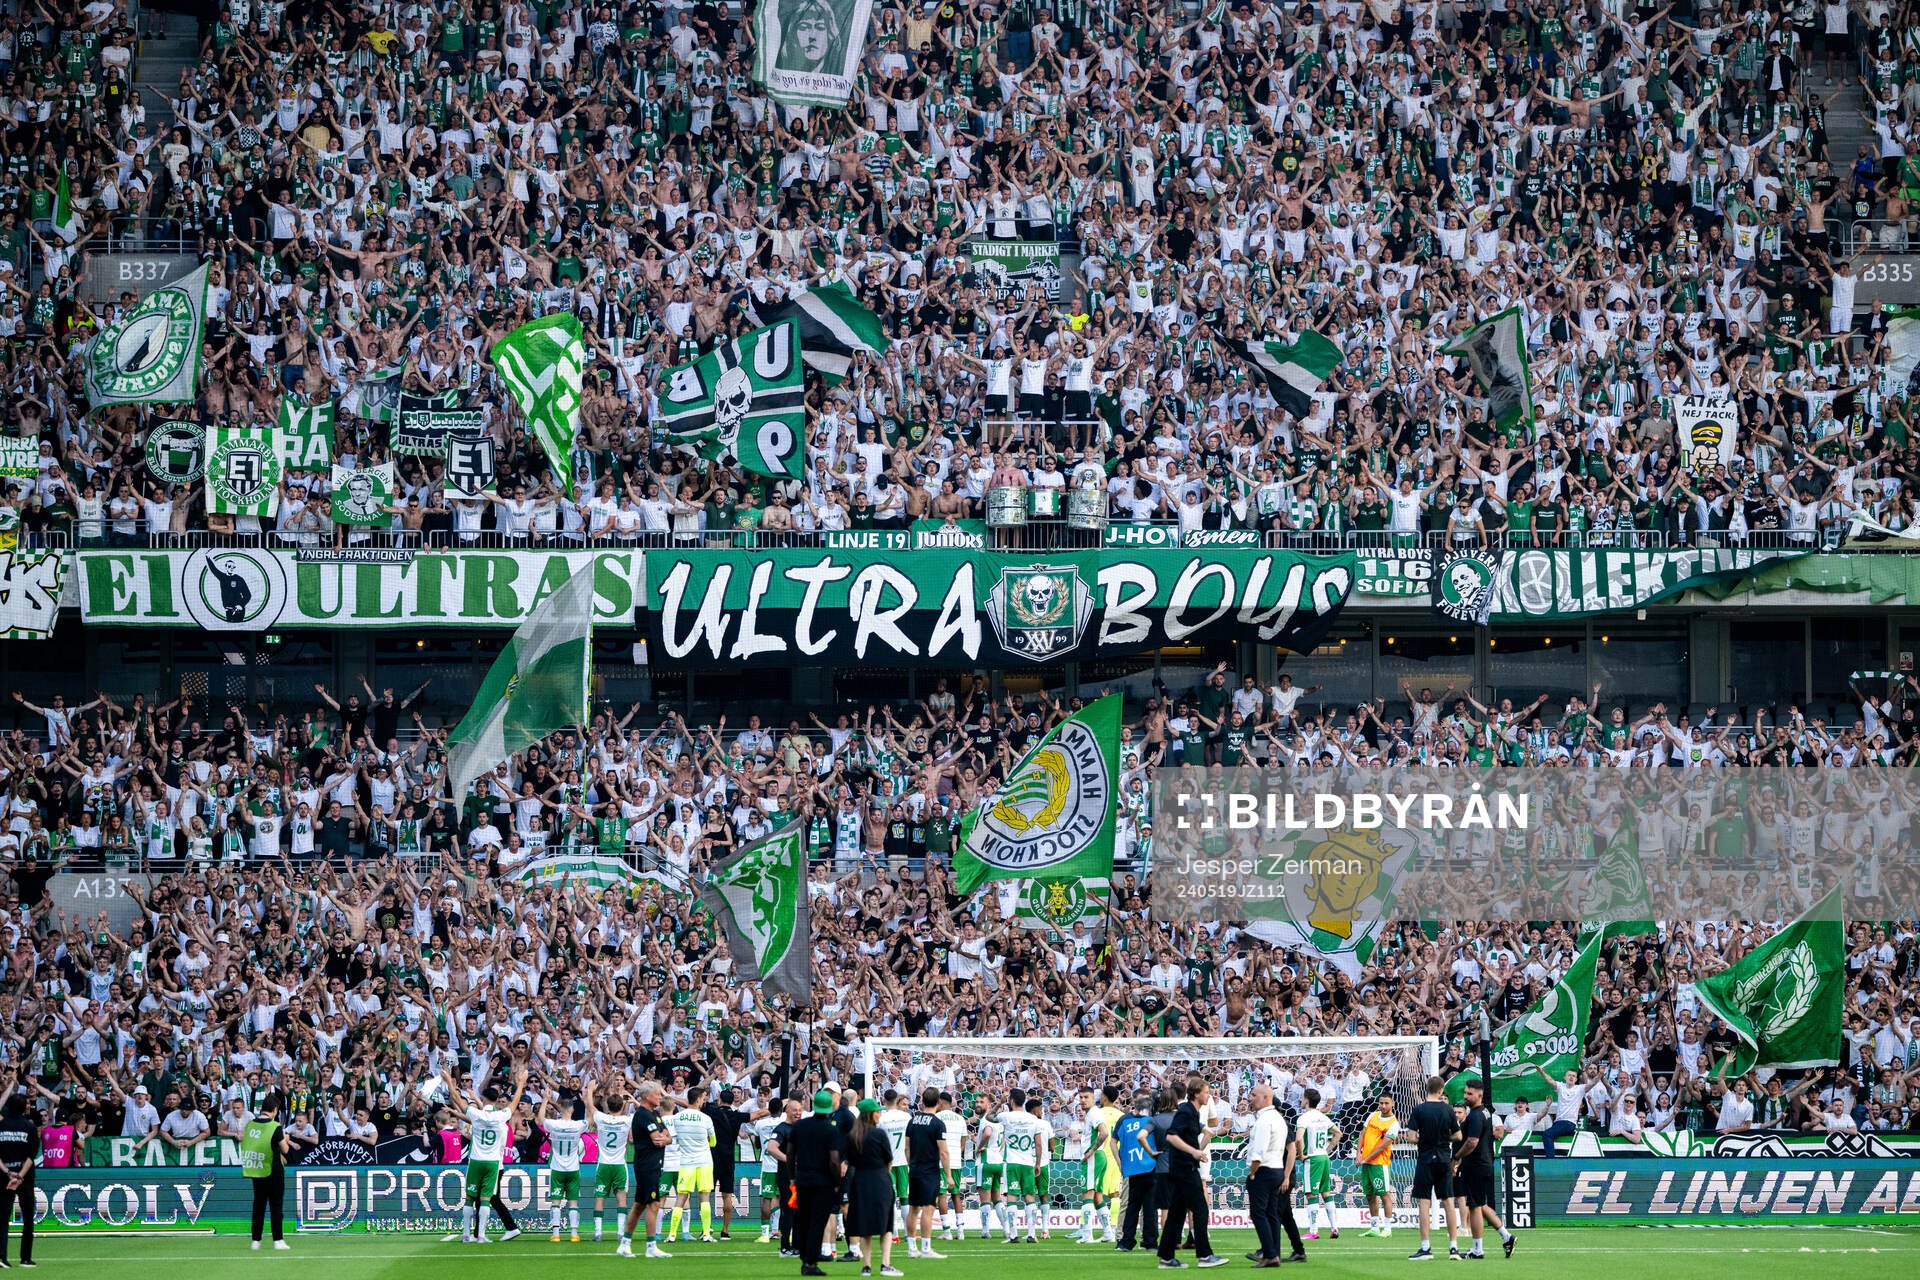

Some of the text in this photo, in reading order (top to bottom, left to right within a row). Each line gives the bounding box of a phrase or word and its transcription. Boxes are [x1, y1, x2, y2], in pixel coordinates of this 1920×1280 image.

[972, 244, 1060, 257] STADIGT I MARKEN
[120, 262, 171, 281] B337
[1863, 263, 1913, 283] B335
[286, 400, 332, 434] YF
[1682, 410, 1735, 421] NEJ TACK!
[213, 438, 276, 462] HAMMARBY
[398, 434, 443, 448] ULTRAS
[283, 434, 329, 468] RA
[451, 441, 491, 474] E1
[229, 456, 259, 481] E1
[335, 470, 354, 486] VITA
[212, 480, 276, 506] STOCKHOLM
[828, 532, 906, 549] LINJE 19
[299, 549, 414, 562] YNGREFRAKTIONEN
[1356, 548, 1432, 560] ULTRA BOYS
[1357, 559, 1432, 580] 116
[294, 552, 636, 618] ULTRAS
[1357, 578, 1430, 594] SOFIA
[657, 554, 983, 661] ULTRA
[73, 877, 132, 899] A137
[679, 1112, 702, 1123] BAJEN
[912, 1115, 933, 1126] BAJEN
[249, 1128, 262, 1139] 02
[1126, 1121, 1140, 1133] 18
[480, 1129, 497, 1146] 19
[605, 1131, 618, 1149] 2
[892, 1132, 903, 1150] 7
[1008, 1134, 1032, 1151] 20
[1315, 1131, 1326, 1149] 15
[111, 1137, 243, 1167] BAEN
[559, 1140, 572, 1156] 11
[1128, 1147, 1144, 1162] TV
[1511, 1157, 1532, 1228] SELECT
[1566, 1171, 1633, 1214] EL
[1648, 1170, 1855, 1214] LINJEN
